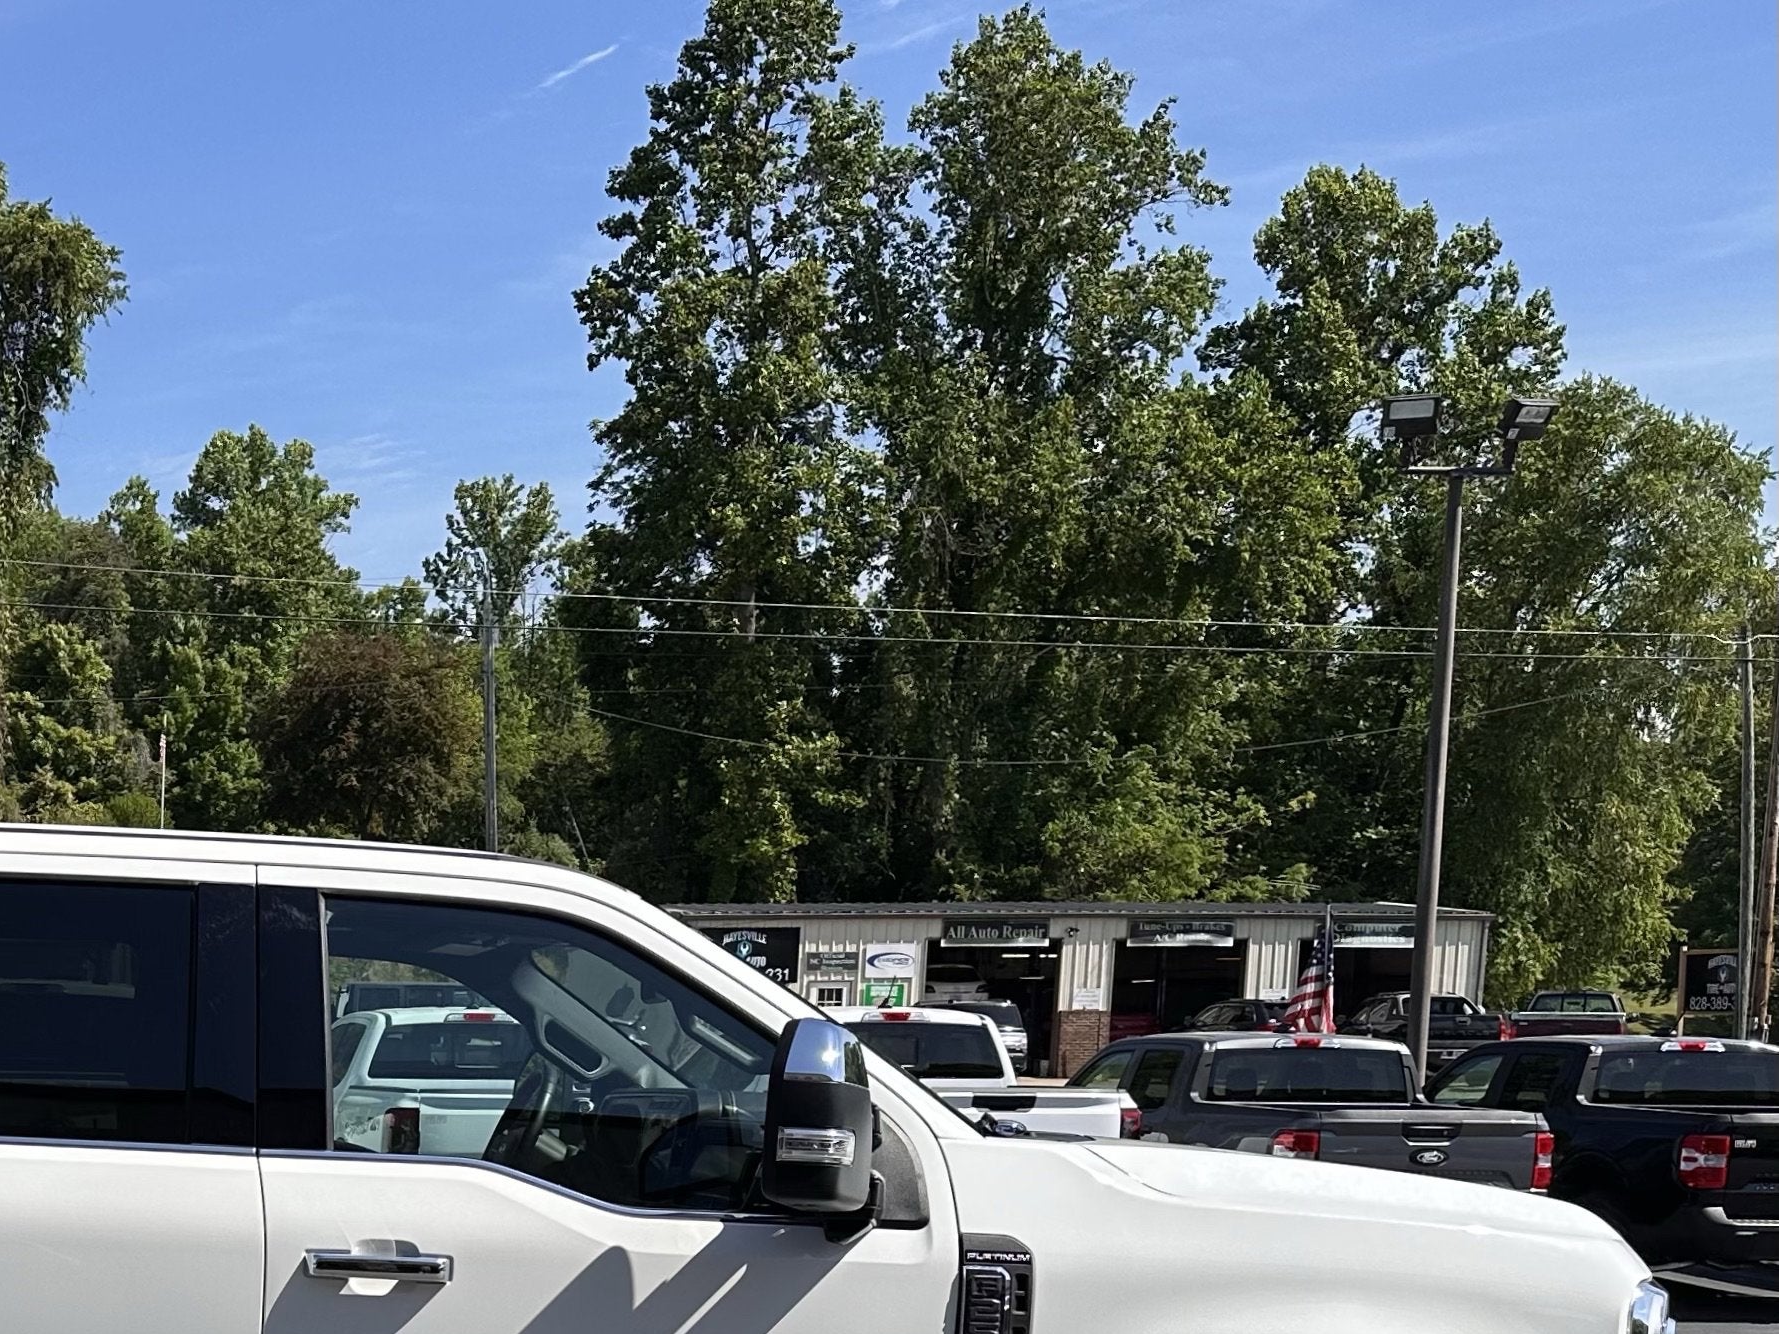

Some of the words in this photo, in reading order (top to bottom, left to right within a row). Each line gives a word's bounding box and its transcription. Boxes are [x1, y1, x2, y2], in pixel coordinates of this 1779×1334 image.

[947, 925, 965, 939] All
[969, 926, 999, 939] Auto
[1002, 925, 1045, 940] Repair
[1334, 922, 1399, 934] Computer
[722, 930, 767, 946] HAYESVILLE
[966, 1252, 1031, 1262] PLATINUM
